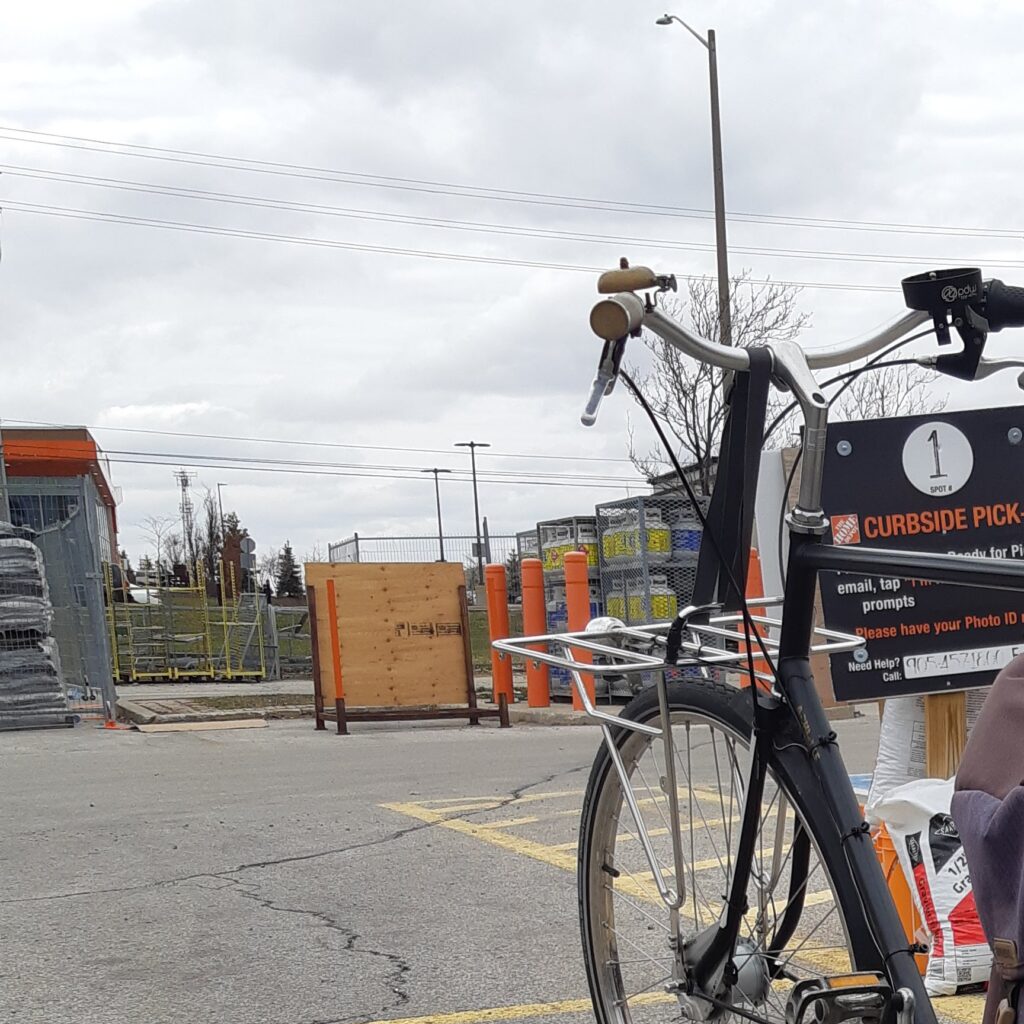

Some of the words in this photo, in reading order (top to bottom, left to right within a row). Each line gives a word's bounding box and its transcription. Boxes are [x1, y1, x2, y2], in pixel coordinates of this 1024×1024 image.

[926, 429, 948, 480] 1
[930, 485, 947, 495] SPOT
[864, 508, 968, 540] CURBSIDE
[837, 578, 877, 595] email,
[879, 577, 901, 593] tap
[862, 595, 916, 615] prompts
[855, 624, 897, 641] Please
[900, 621, 931, 637] have
[933, 617, 963, 636] your
[965, 614, 1001, 631] Photo
[1004, 611, 1018, 625] ID
[848, 660, 872, 672] Need
[874, 656, 901, 670] Help?
[882, 671, 903, 683] Call:
